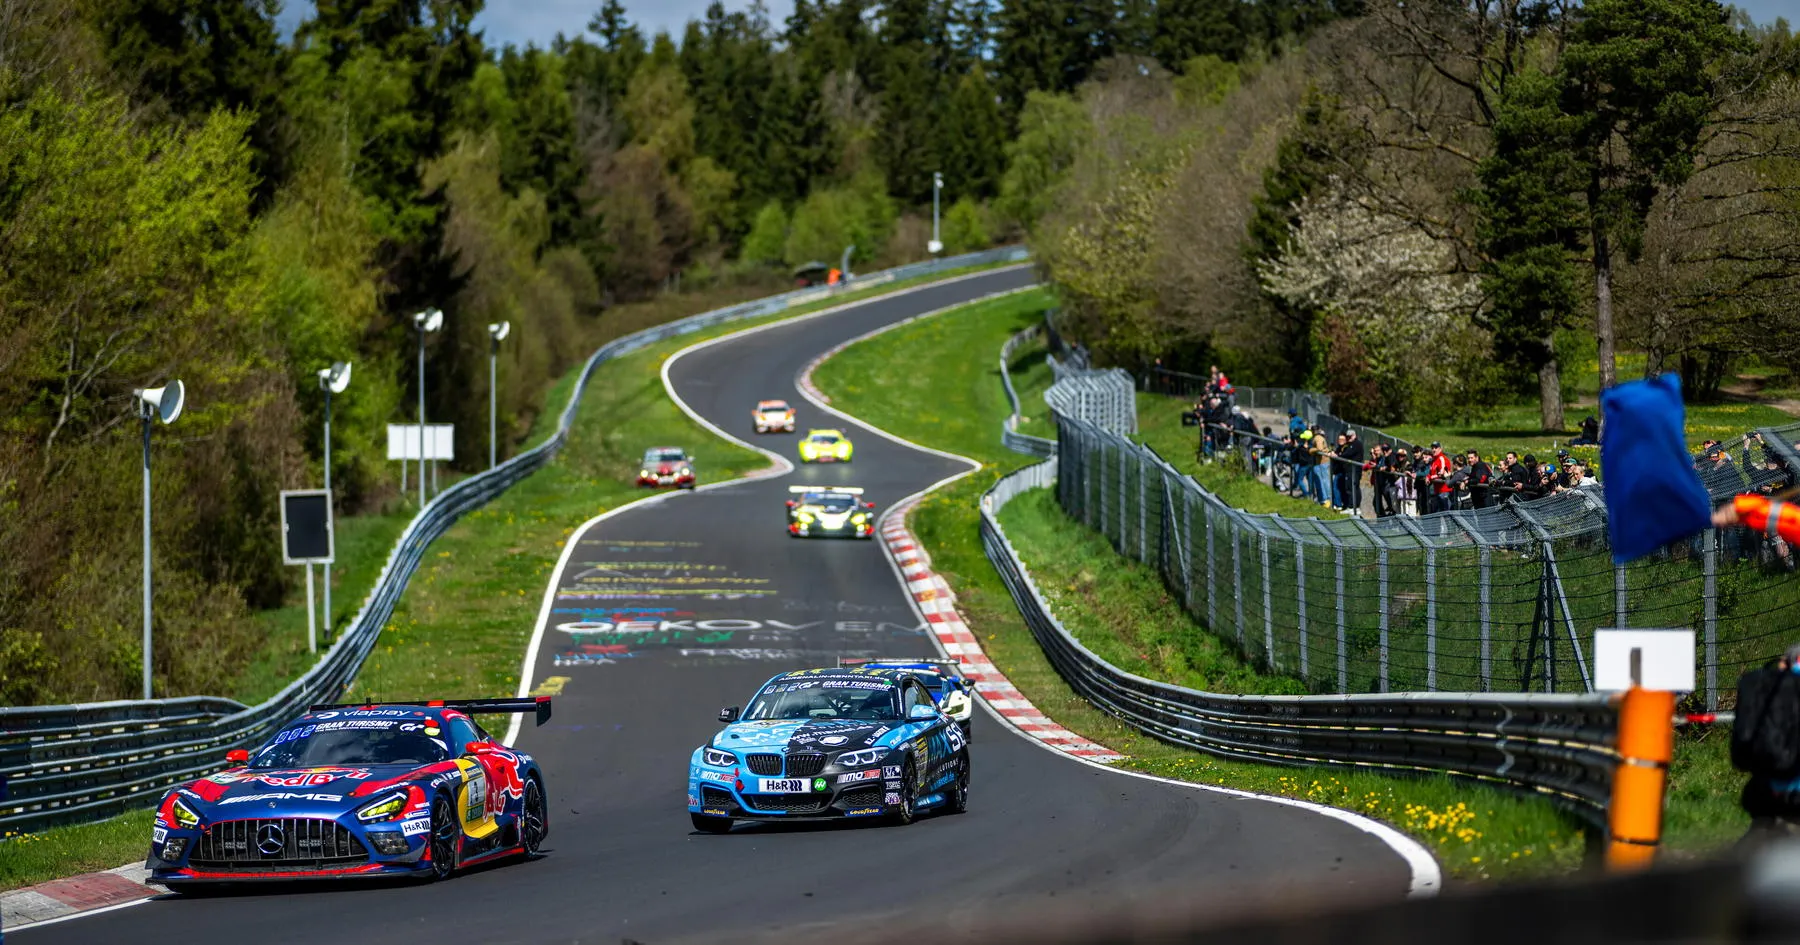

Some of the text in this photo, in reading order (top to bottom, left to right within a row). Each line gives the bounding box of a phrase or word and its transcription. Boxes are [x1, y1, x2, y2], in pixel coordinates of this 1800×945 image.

[845, 681, 892, 690] TURISMO
[343, 709, 412, 717] viaplay
[316, 721, 348, 730] GRAN
[348, 720, 393, 728] TURISMO
[766, 779, 789, 791] H&R
[258, 792, 343, 803] AMG
[403, 821, 423, 833] H&R
